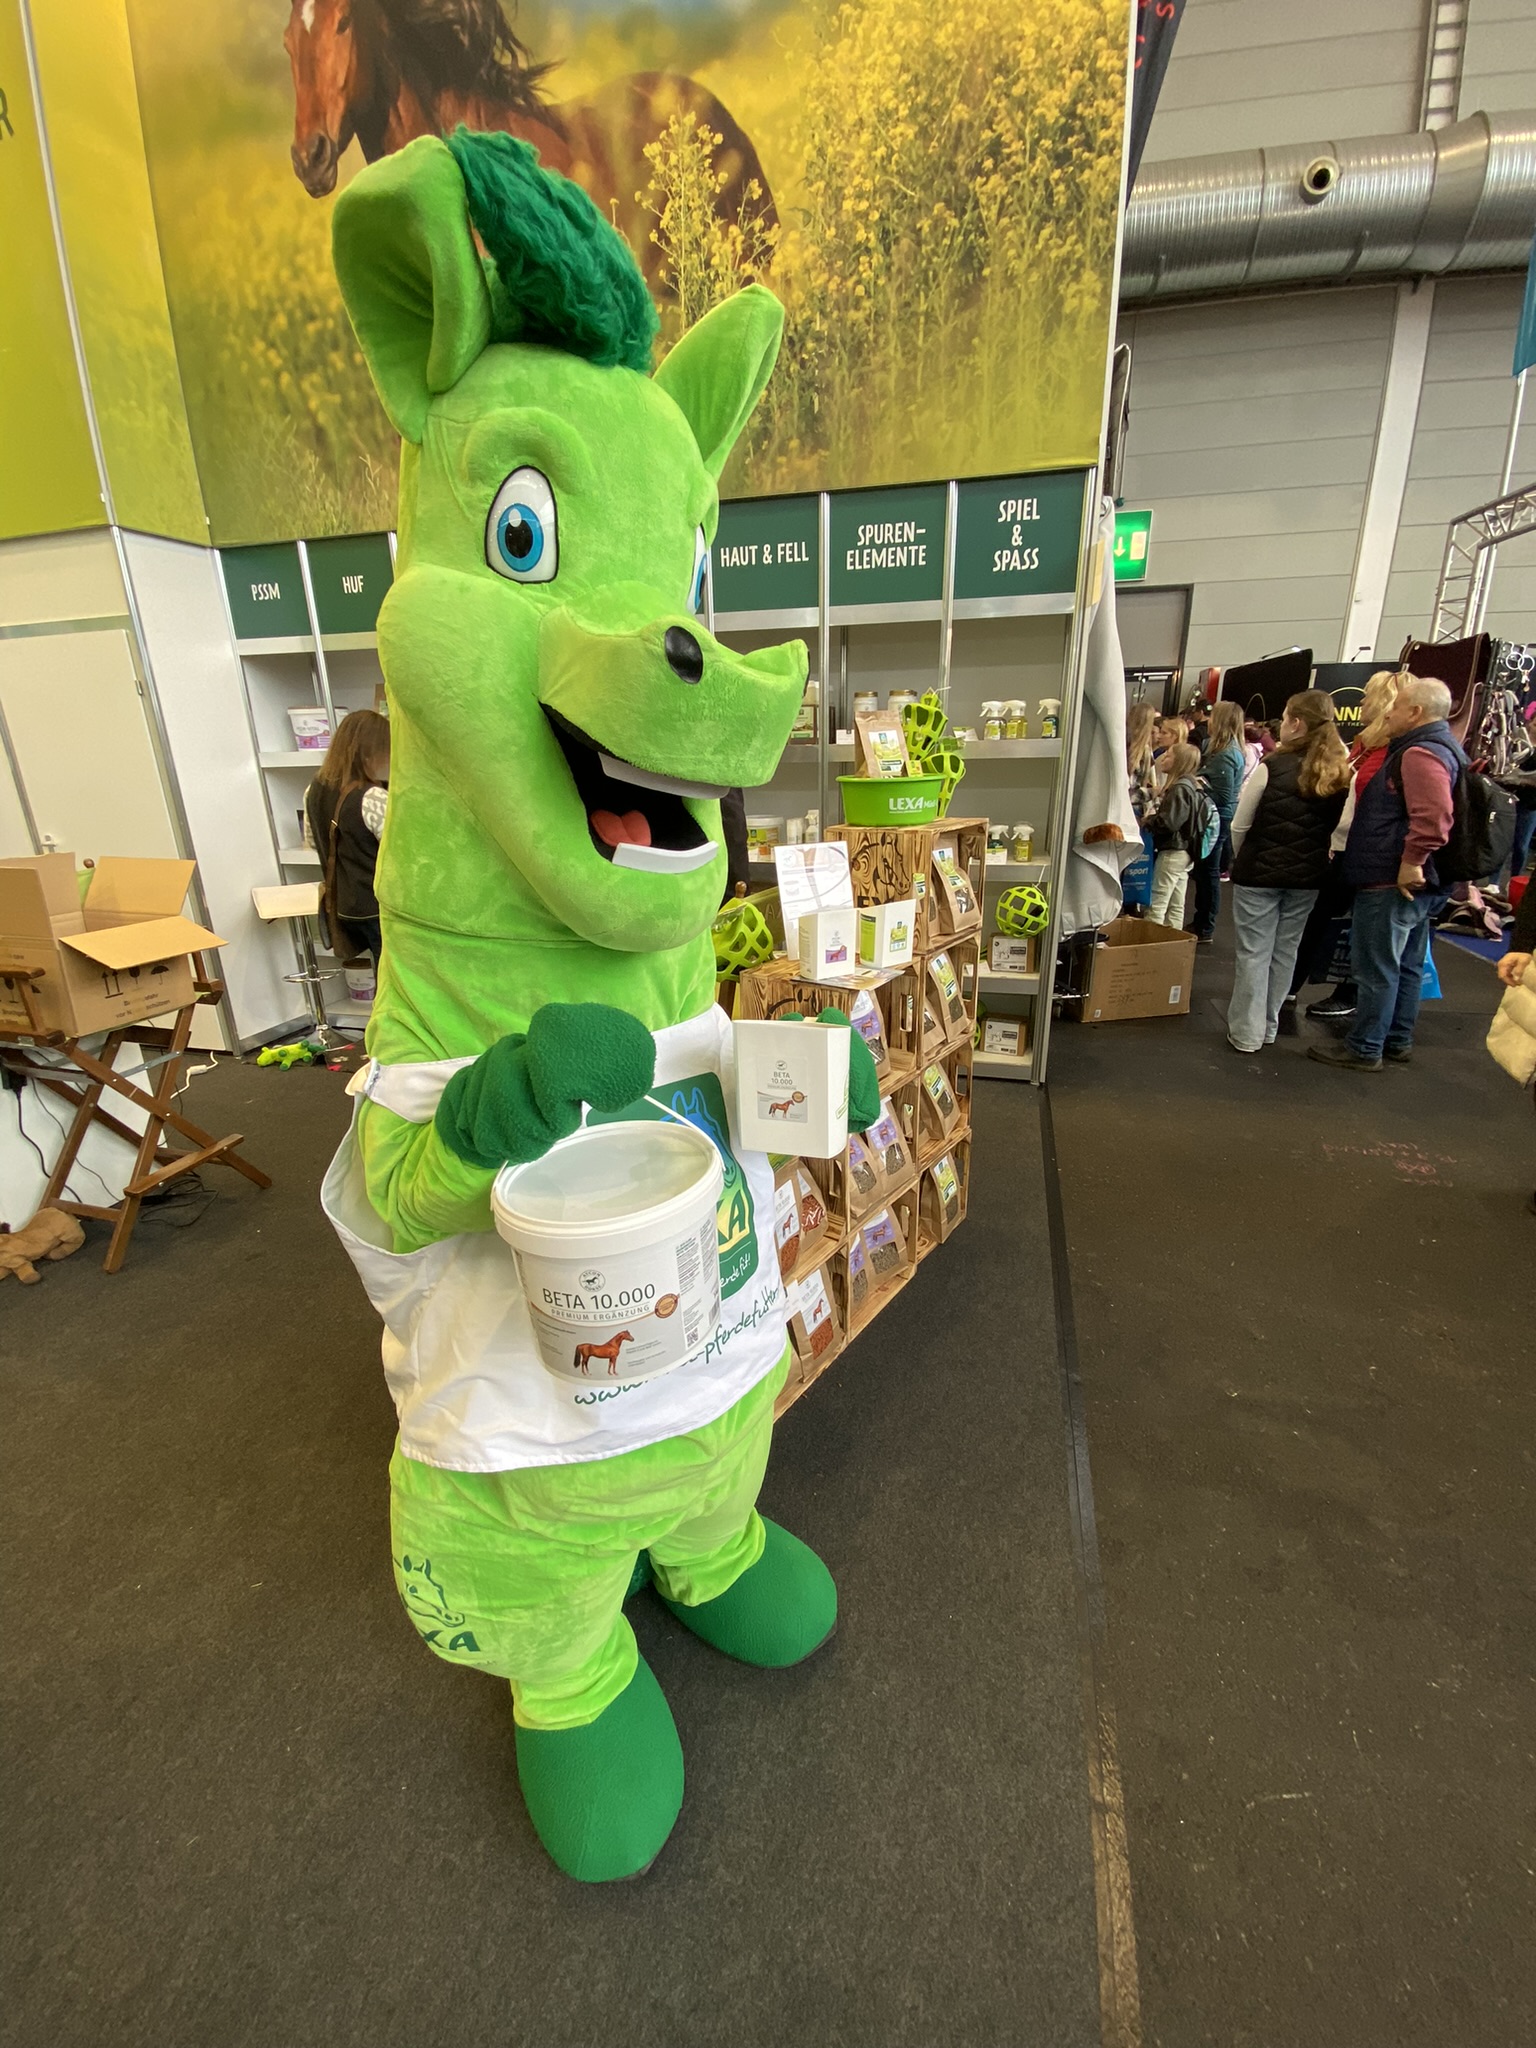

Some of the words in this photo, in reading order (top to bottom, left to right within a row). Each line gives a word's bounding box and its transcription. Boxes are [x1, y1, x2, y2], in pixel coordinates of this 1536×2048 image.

[997, 498, 1040, 523] SPIEL
[857, 521, 926, 547] SPUREN-
[1011, 524, 1023, 547] &
[720, 544, 757, 568] HAUT
[762, 543, 773, 565] &
[777, 541, 809, 564] FELL
[846, 545, 927, 571] ELEMENTE
[992, 548, 1039, 573] SPASS
[251, 582, 281, 601] PSSM
[342, 575, 364, 594] HUF
[889, 796, 924, 811] LEXA
[773, 1071, 791, 1079] BETA
[542, 1287, 586, 1310] BETA
[590, 1283, 656, 1310] 10.000
[551, 1308, 590, 1321] PREMIUM
[593, 1304, 650, 1321] ERGÄNZUNG
